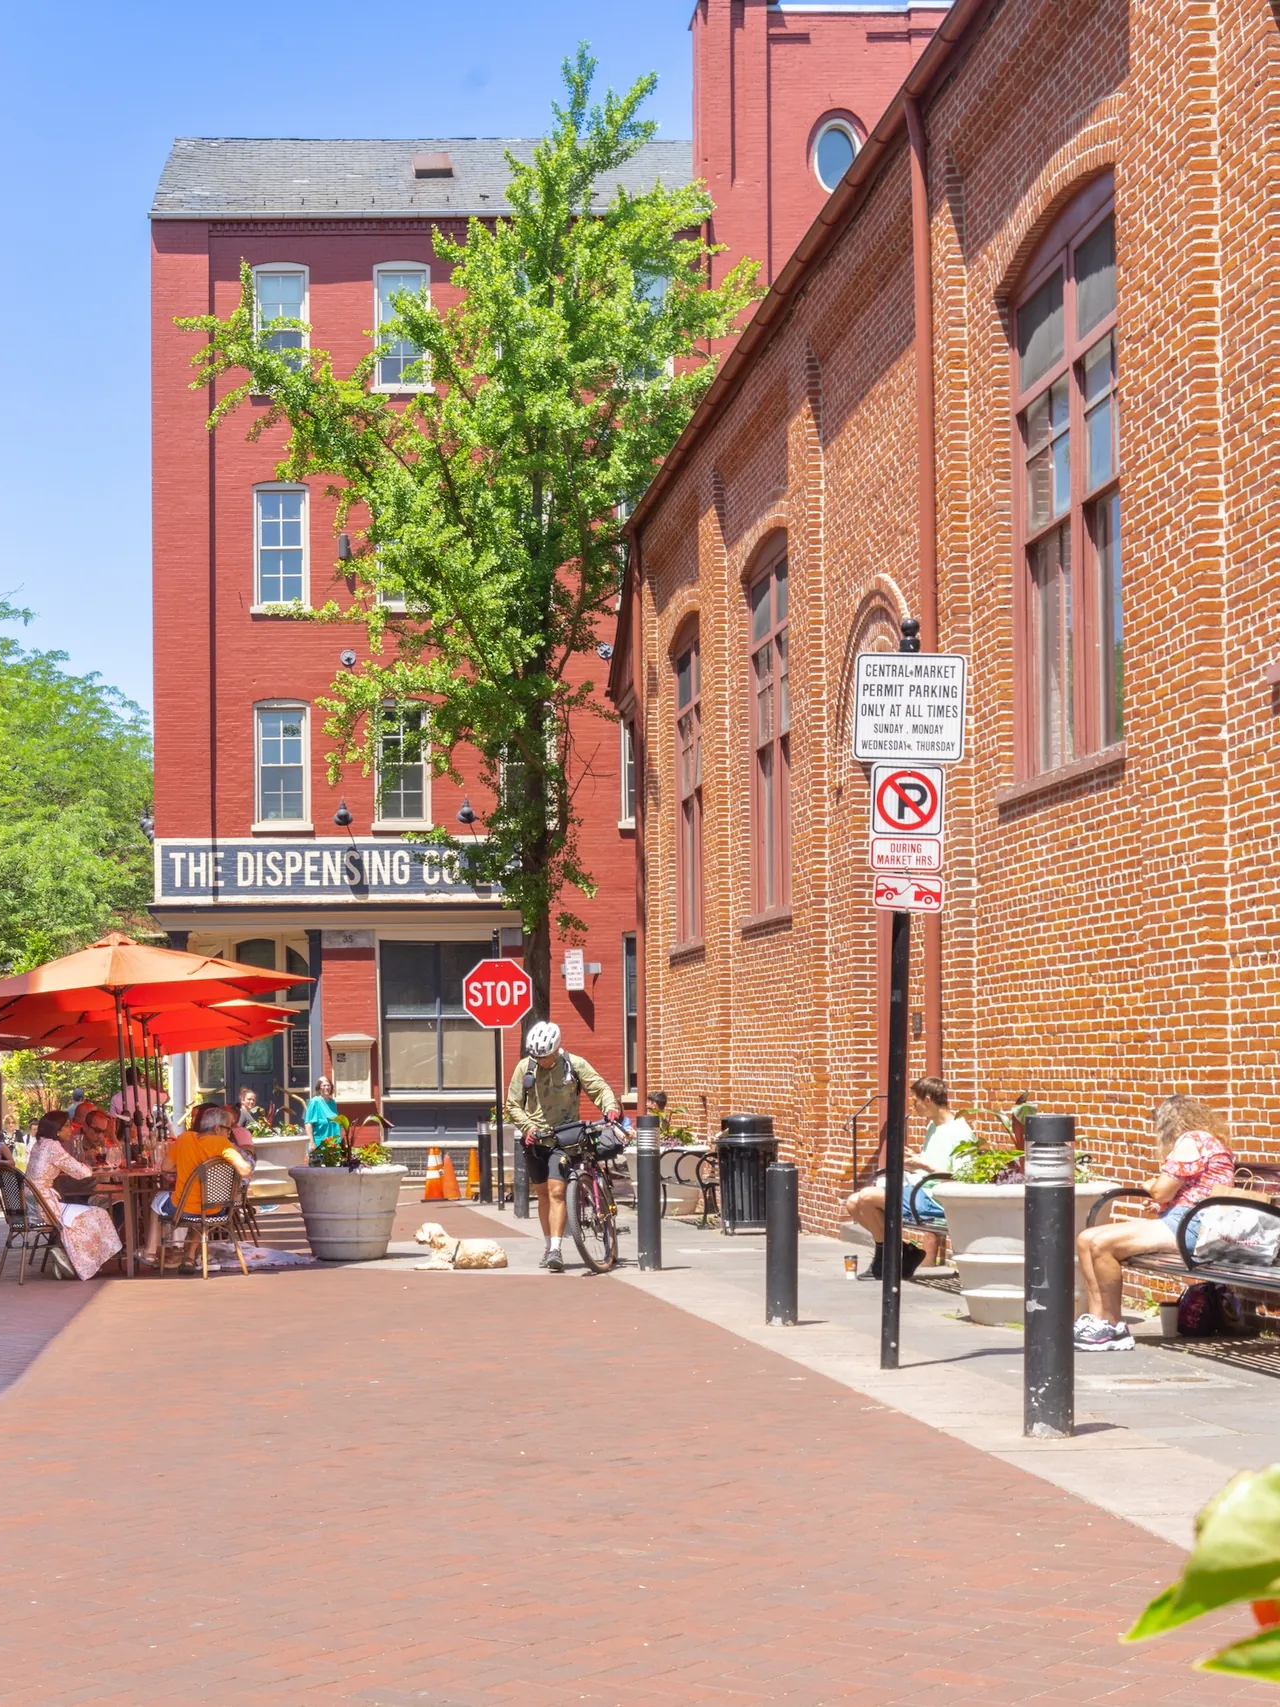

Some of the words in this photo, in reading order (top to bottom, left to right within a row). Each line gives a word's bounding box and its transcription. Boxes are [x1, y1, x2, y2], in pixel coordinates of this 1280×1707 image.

[865, 664, 910, 678] CENTRAL
[914, 665, 956, 679] MARKET
[862, 684, 904, 697] PERMIT
[909, 685, 958, 698] PARKING
[860, 704, 886, 718] ONLY
[889, 704, 903, 717] AT
[905, 704, 923, 717] ALL
[927, 705, 958, 718] TIMES
[912, 724, 944, 734] MONDAY
[916, 741, 956, 751] THURSDAY
[890, 843, 922, 853] DURING
[877, 854, 912, 865] MARKET
[915, 855, 935, 866] HRS.
[169, 852, 225, 888] THE
[237, 850, 411, 887] DISPENSING
[342, 934, 353, 943] 35
[469, 981, 527, 1007] STOP
